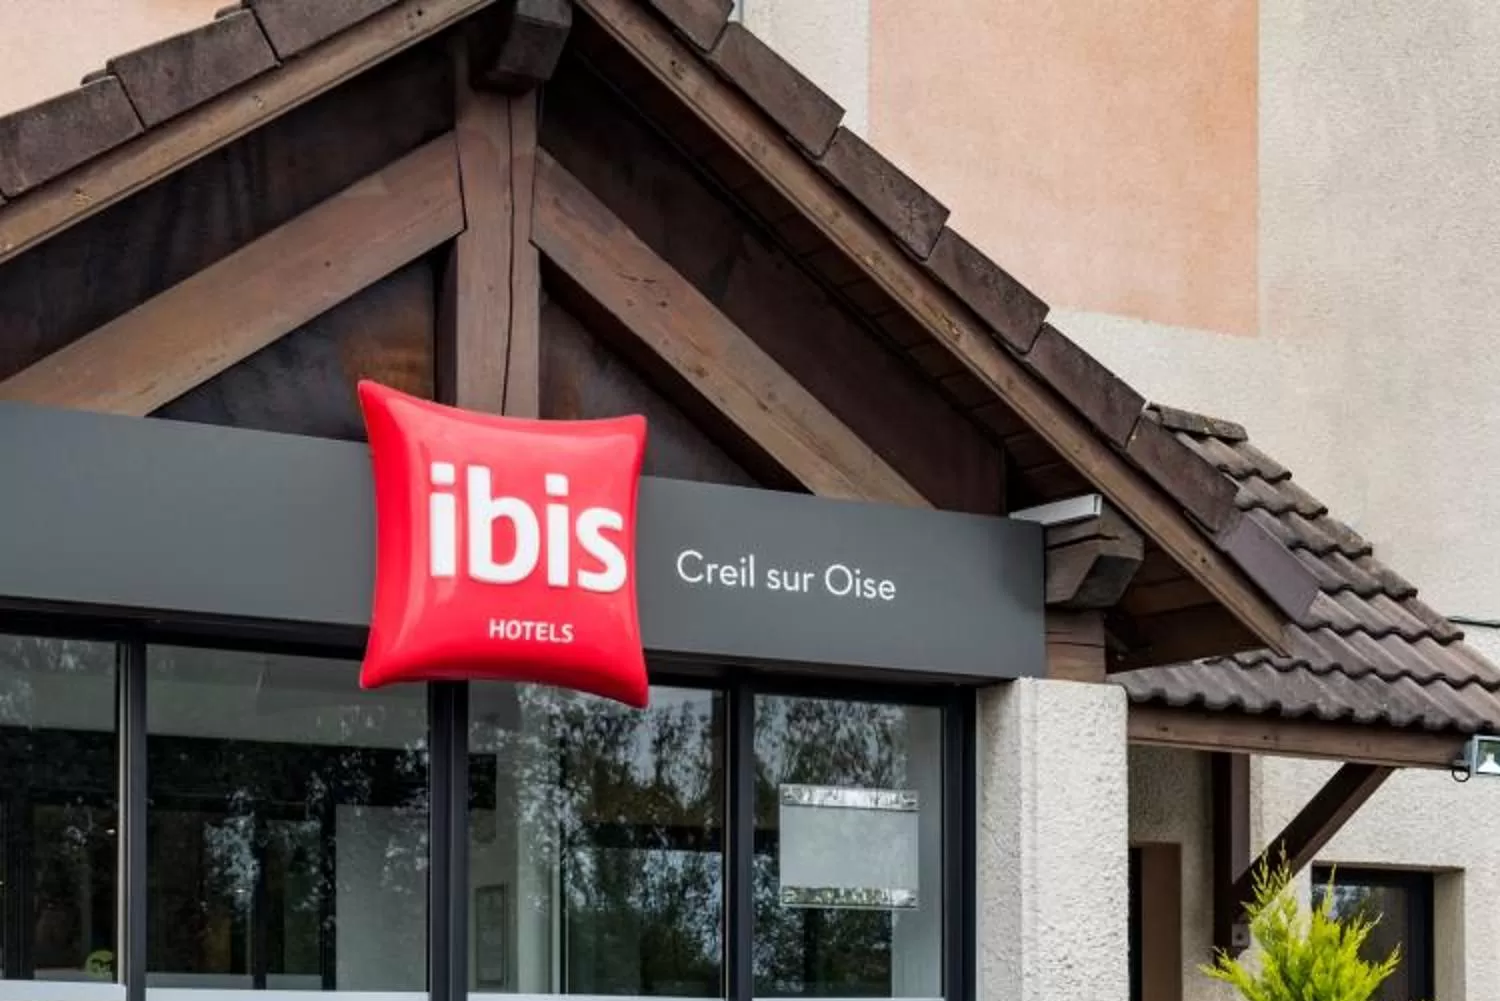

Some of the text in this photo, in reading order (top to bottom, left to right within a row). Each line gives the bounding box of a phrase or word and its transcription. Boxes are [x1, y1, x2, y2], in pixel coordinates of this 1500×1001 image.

[429, 462, 627, 592] ibis
[676, 550, 896, 601] Creil sur Oise
[489, 618, 574, 644] HOTELS
